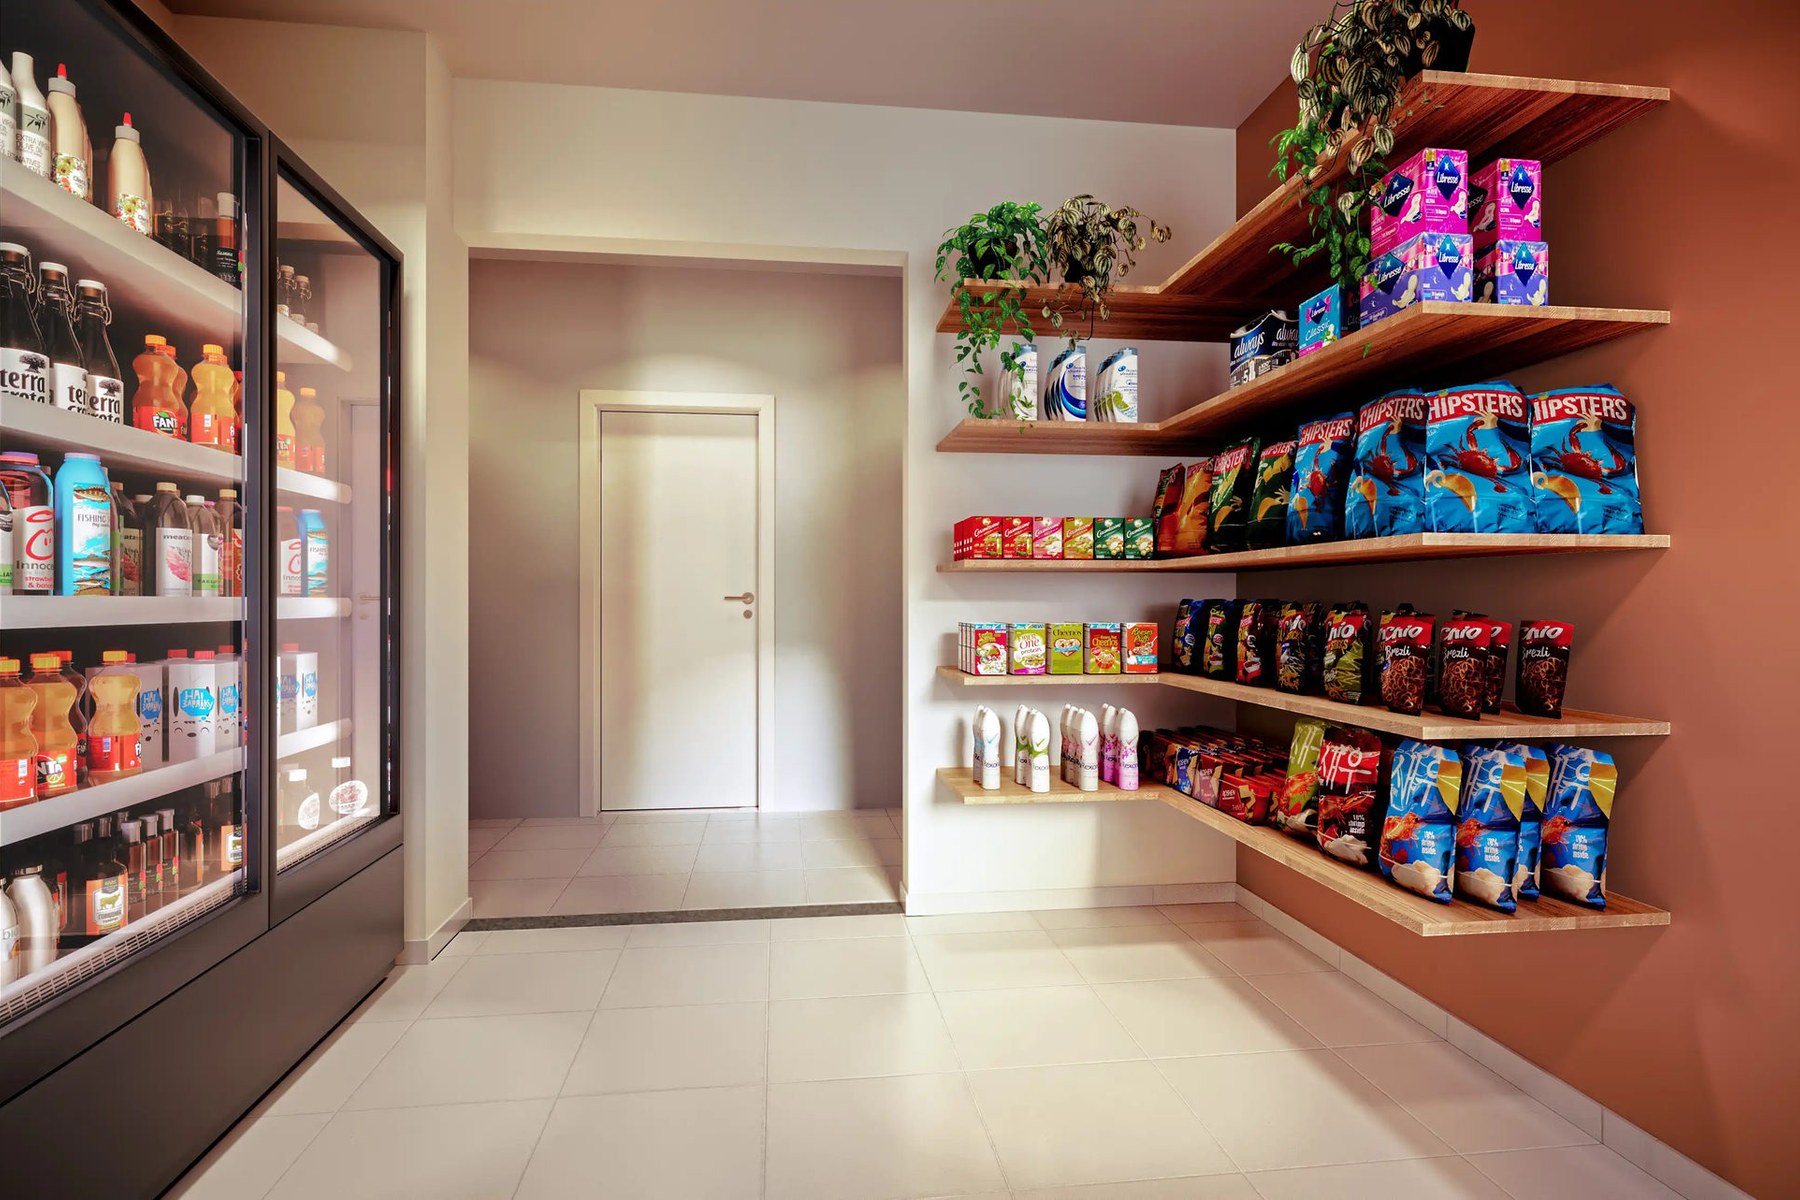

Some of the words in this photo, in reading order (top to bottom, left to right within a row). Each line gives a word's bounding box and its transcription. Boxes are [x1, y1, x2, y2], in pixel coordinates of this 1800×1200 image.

[1437, 172, 1459, 184] Libresse
[1511, 181, 1533, 193] Libresse
[1384, 185, 1411, 208] Libresse
[1439, 252, 1459, 263] Libresse
[1515, 260, 1535, 270] Libresse
[1378, 266, 1402, 285] Libresse
[1305, 319, 1331, 341] Classic
[1234, 332, 1266, 358] always
[0, 369, 45, 393] terra
[68, 385, 87, 406] ter
[89, 395, 120, 415] erra
[1430, 391, 1523, 421] HIPSTER'S
[153, 415, 178, 429] FANT
[16, 561, 54, 571] Innoc
[1052, 629, 1082, 637] Cheerios
[1020, 638, 1040, 650] One
[1092, 637, 1119, 648] Cheerios
